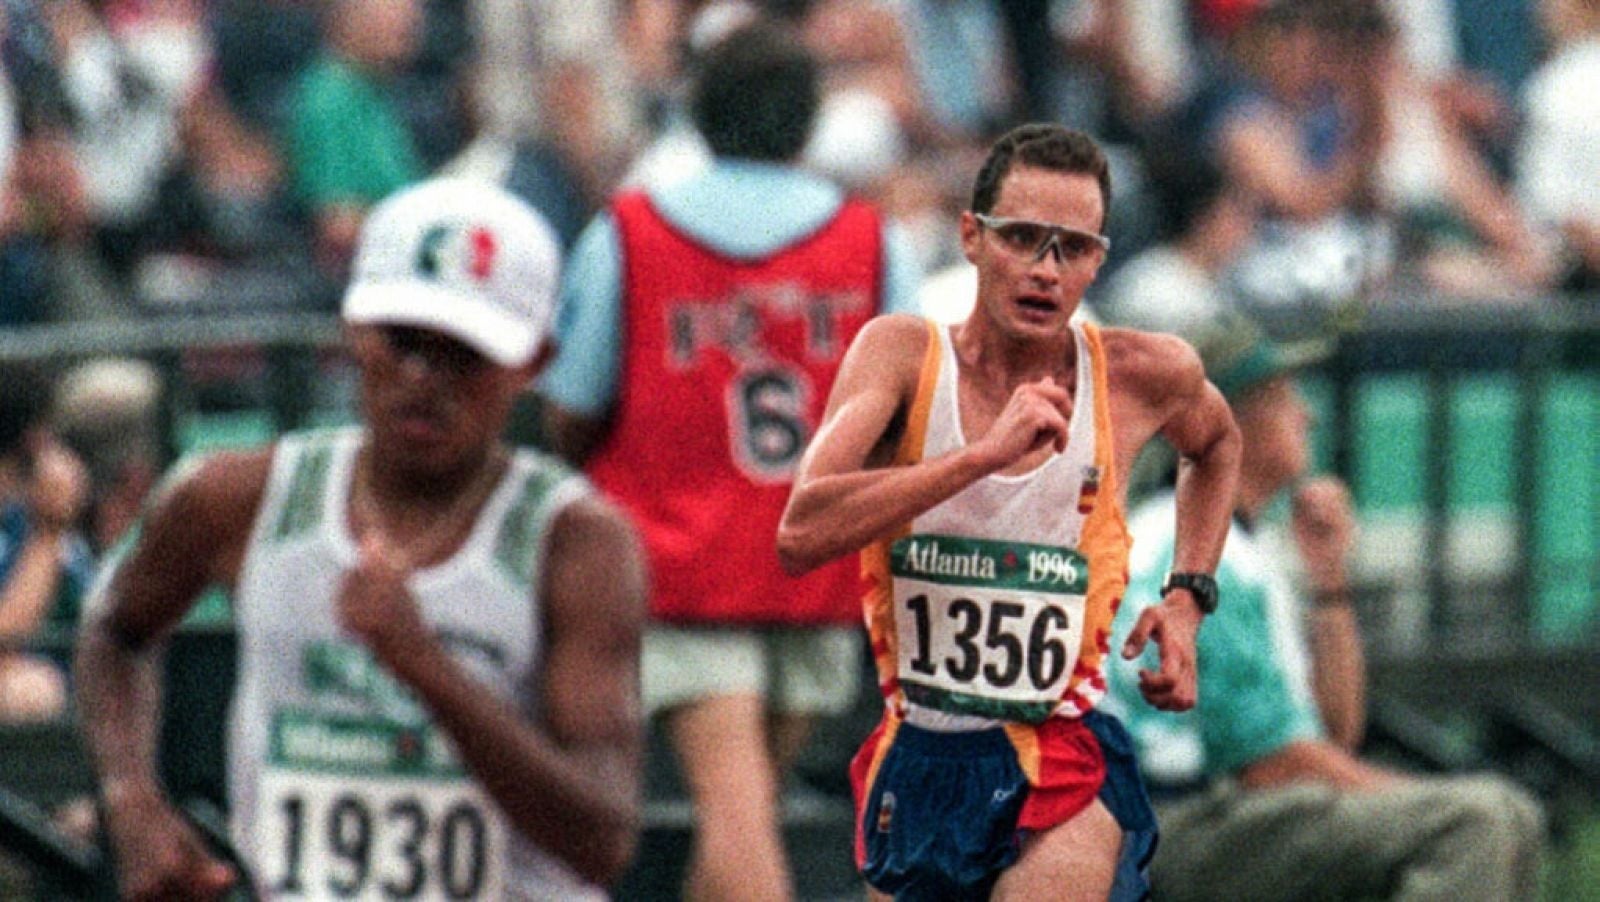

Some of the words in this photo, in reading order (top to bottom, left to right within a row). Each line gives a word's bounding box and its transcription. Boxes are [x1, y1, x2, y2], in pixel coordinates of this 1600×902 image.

[736, 368, 808, 473] 6
[905, 540, 996, 579] Atlanta
[1027, 551, 1078, 585] 1996
[907, 593, 1069, 691] 1356
[275, 797, 486, 900] 1930
